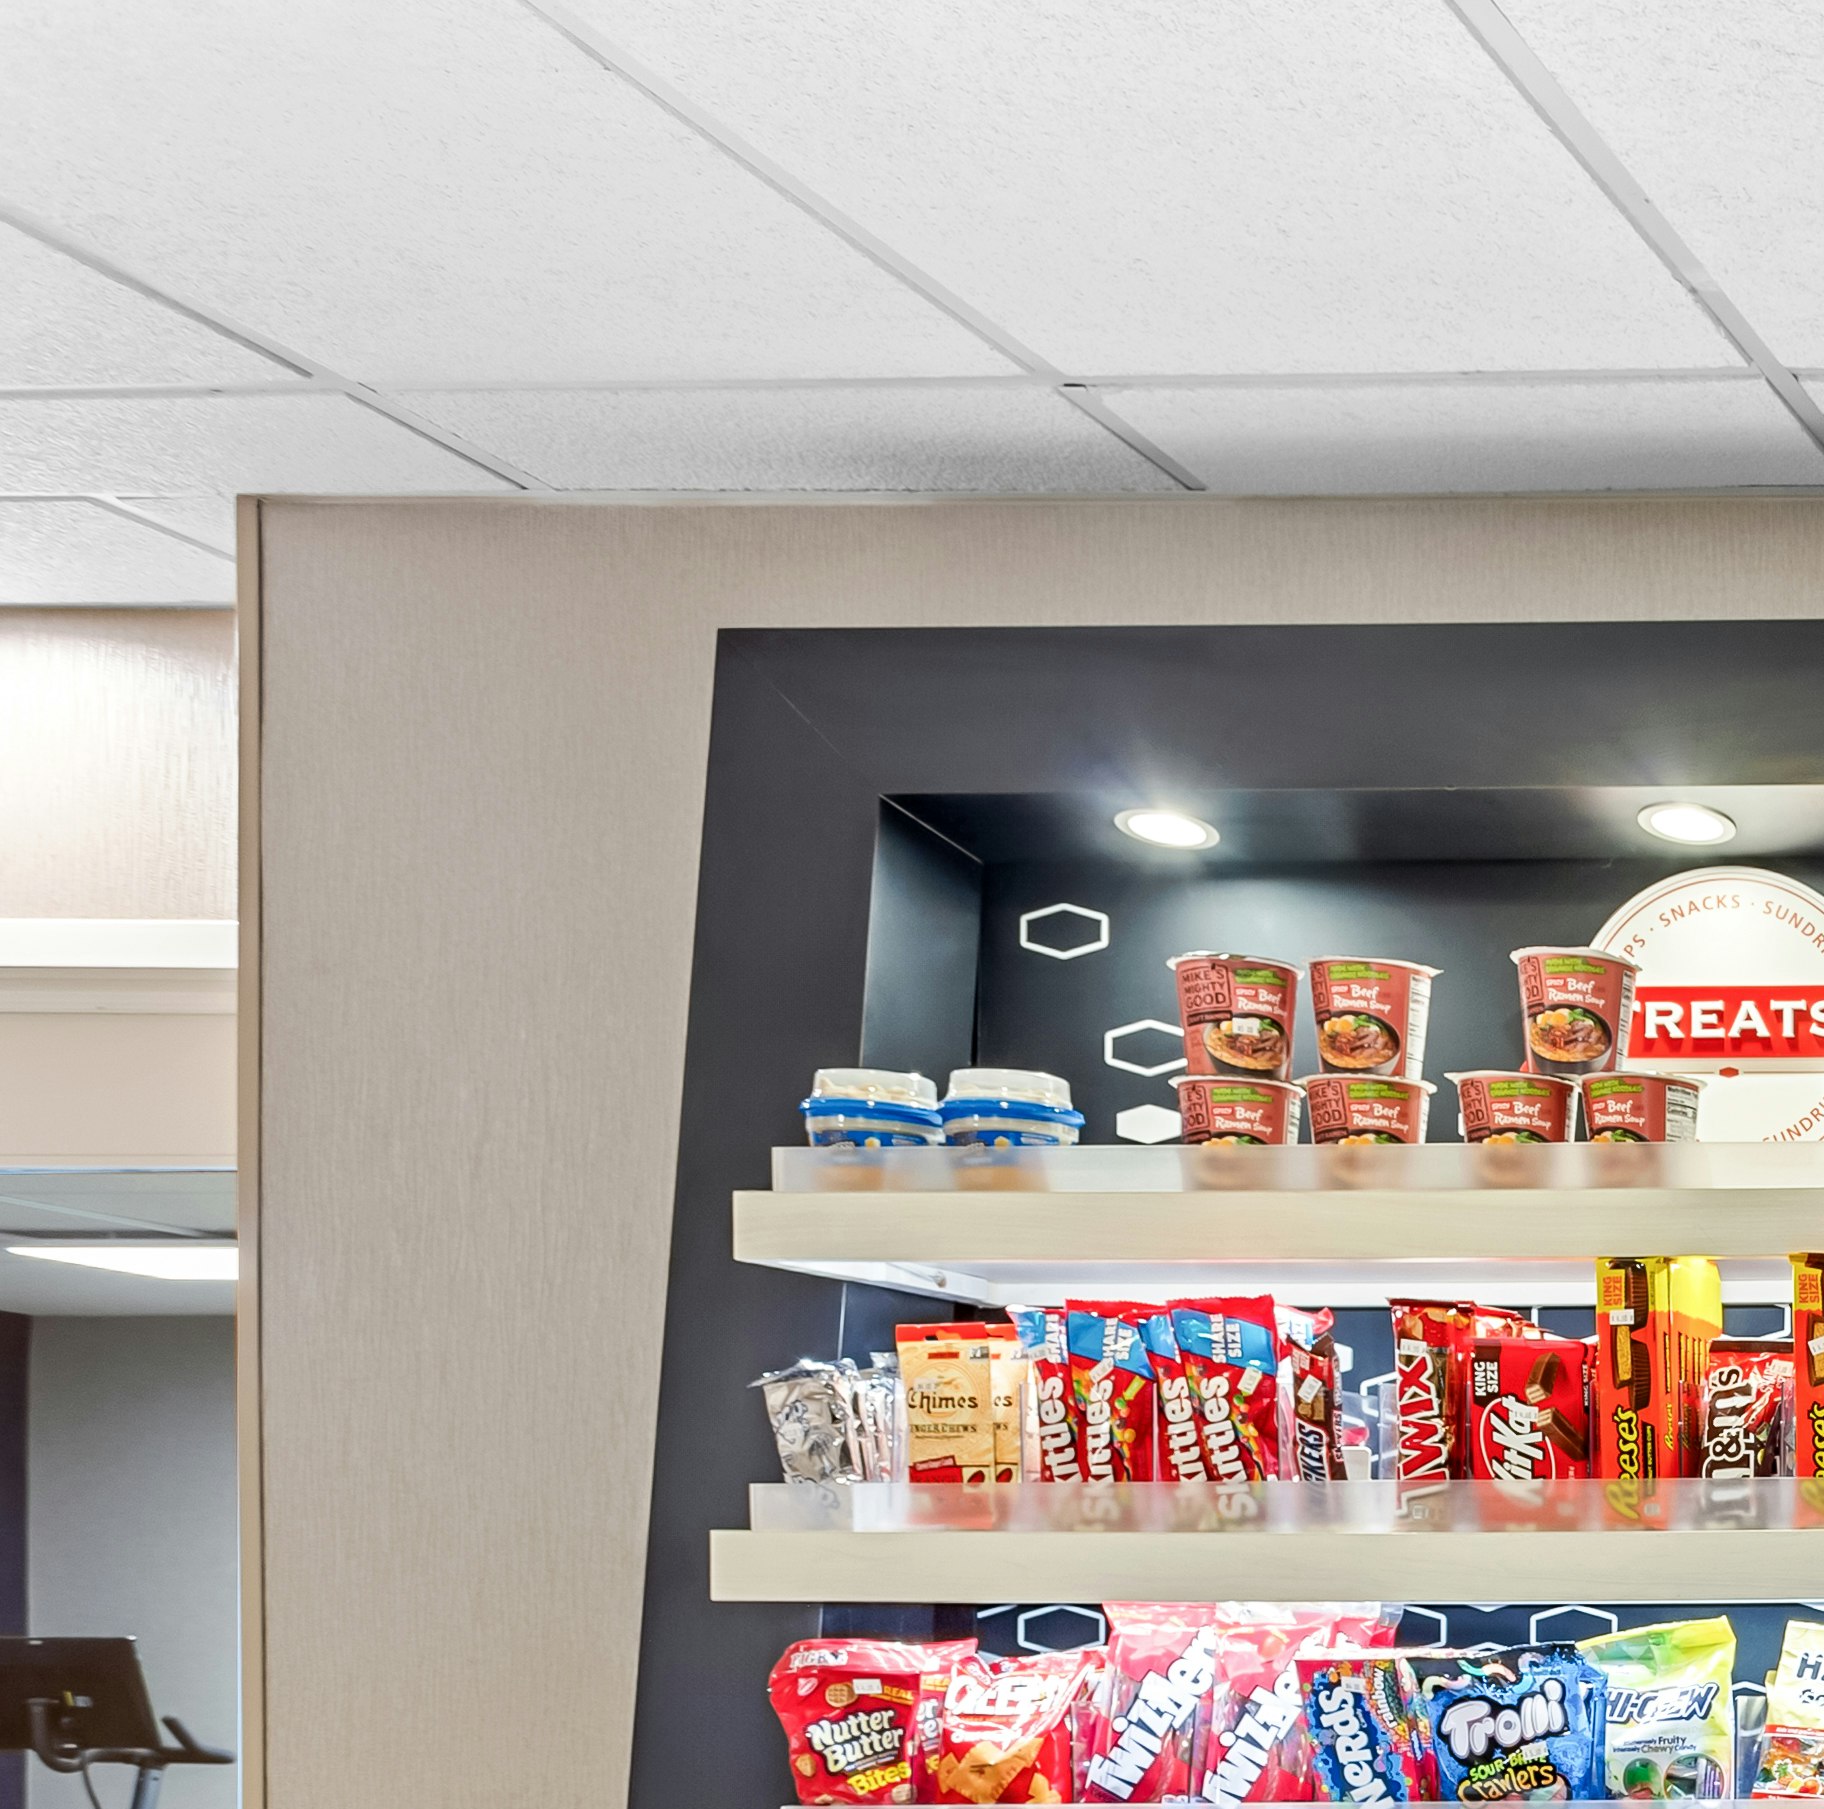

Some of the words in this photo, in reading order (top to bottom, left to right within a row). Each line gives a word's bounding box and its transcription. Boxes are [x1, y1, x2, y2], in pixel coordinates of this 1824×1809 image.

[1658, 893, 1742, 929] SNACKS
[1186, 993, 1226, 1010] GOOD
[1257, 988, 1282, 1004] Beef
[1350, 984, 1380, 1000] Beef
[1566, 976, 1596, 993] Beef
[1474, 1361, 1486, 1397] KING
[1486, 1361, 1499, 1394] SIZE
[804, 1708, 895, 1753] Nutter
[1439, 1678, 1566, 1760] Trolli
[823, 1726, 904, 1773] Butter
[847, 1761, 913, 1796] Bites
[1456, 1764, 1556, 1804] Crawlers
